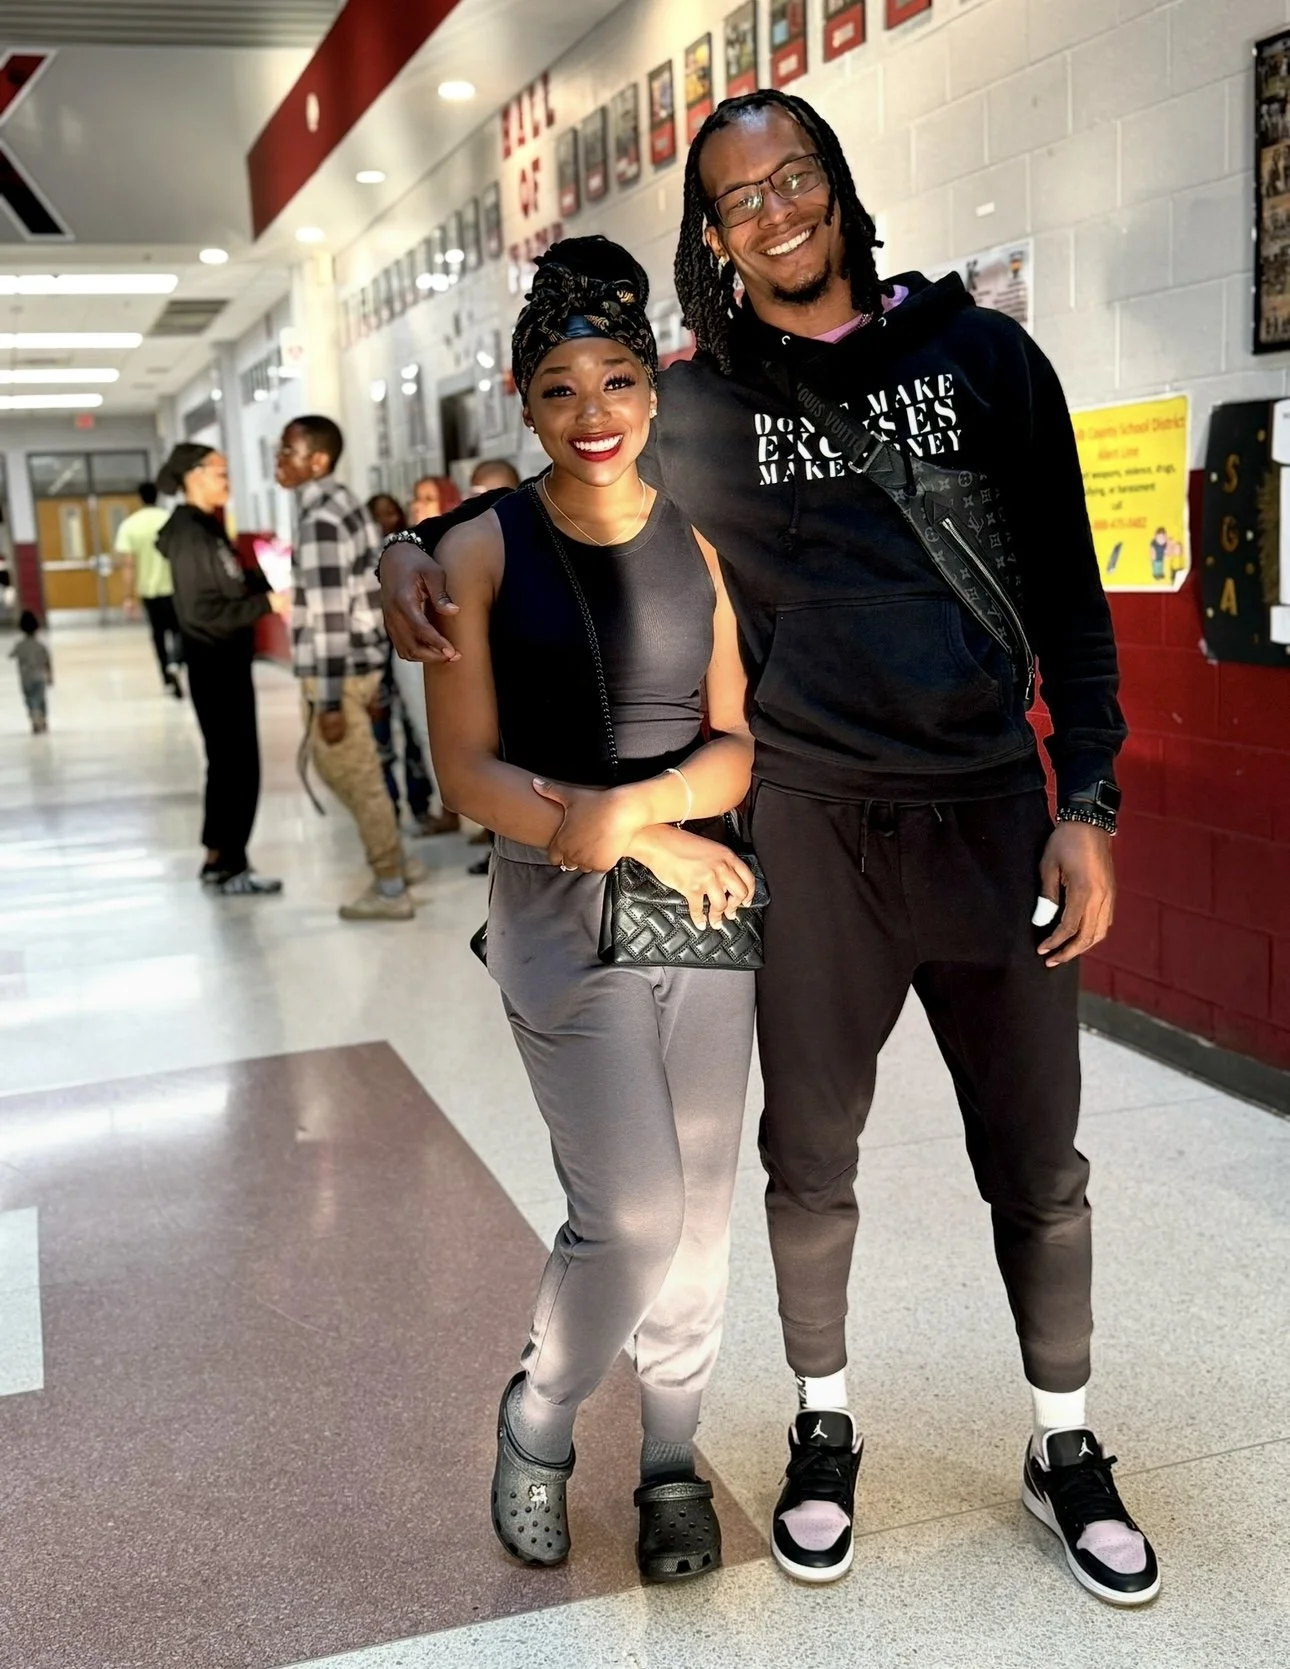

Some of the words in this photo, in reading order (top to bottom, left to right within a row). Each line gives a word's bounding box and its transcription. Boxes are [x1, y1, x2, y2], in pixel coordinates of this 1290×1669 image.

[867, 374, 955, 417] MAKE
[758, 398, 957, 463] EXCSES
[759, 459, 846, 486] MAKE
